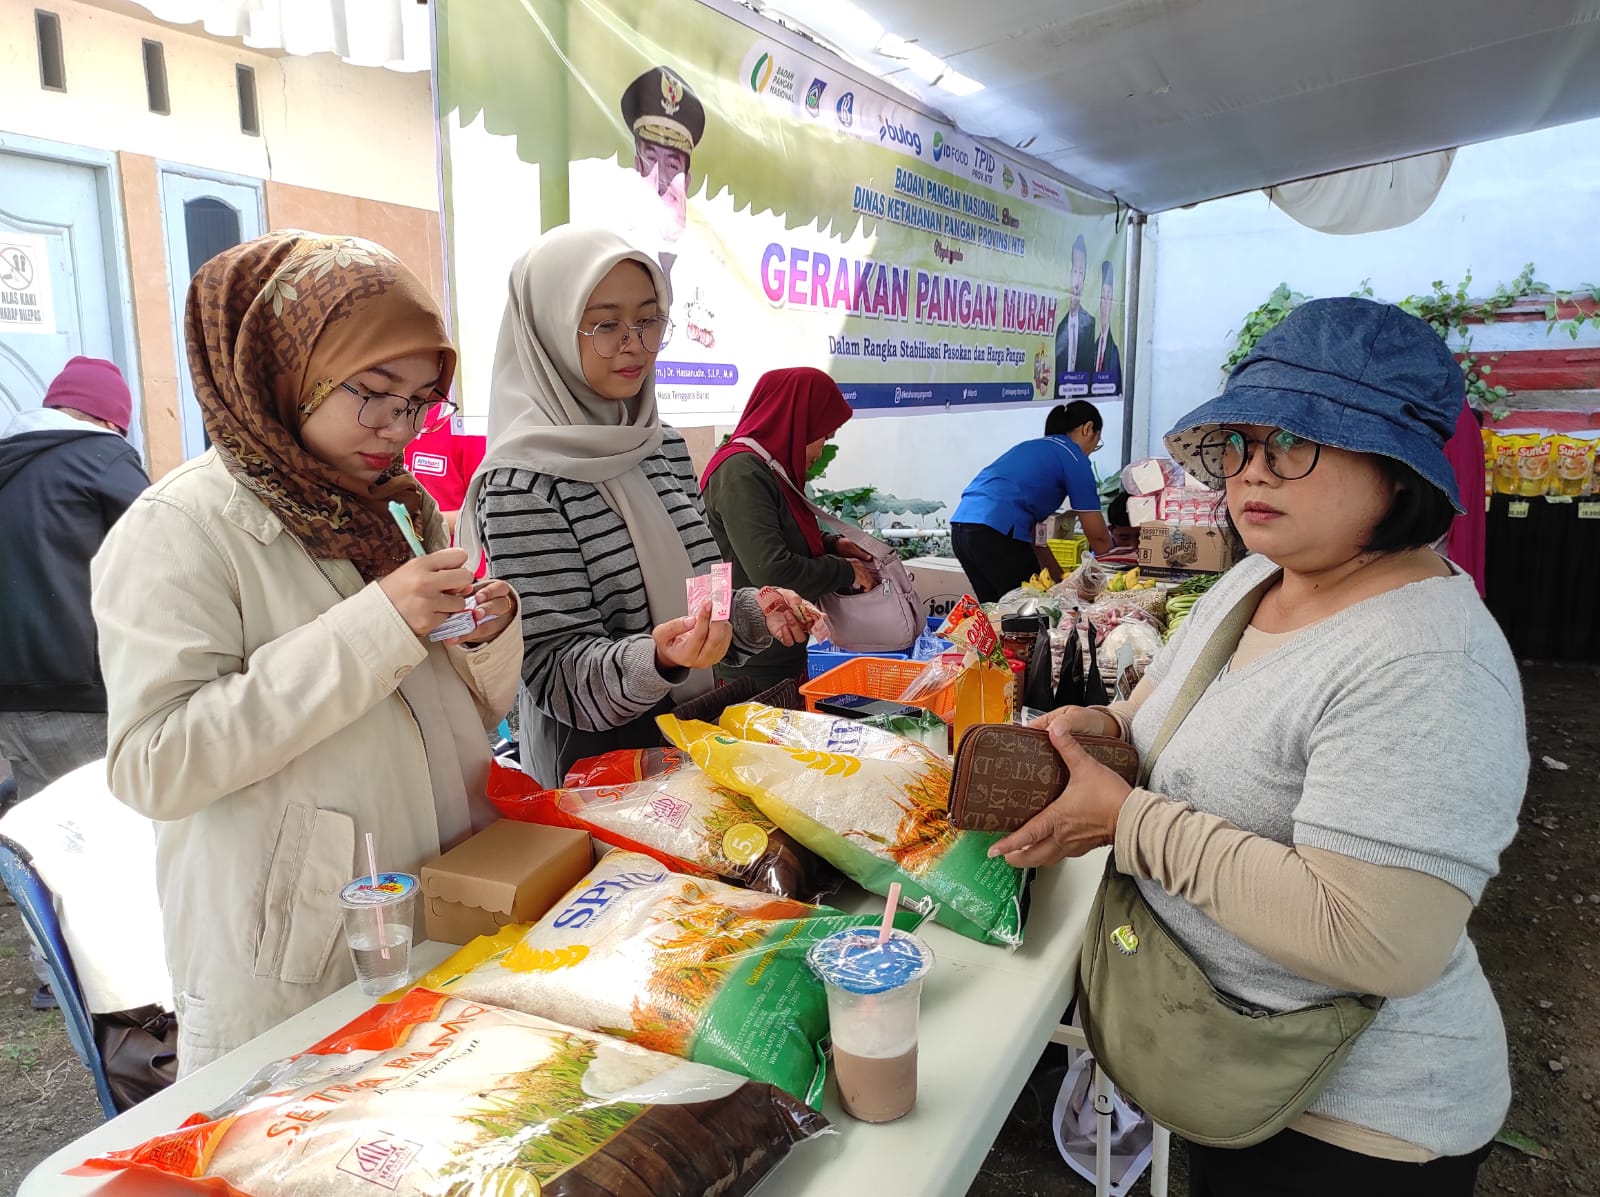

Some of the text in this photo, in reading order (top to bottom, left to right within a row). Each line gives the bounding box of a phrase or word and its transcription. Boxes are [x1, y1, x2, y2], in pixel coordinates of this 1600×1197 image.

[773, 74, 794, 91] PANGAN
[775, 65, 795, 82] BADAN
[769, 85, 795, 104] NASIONAL
[884, 119, 922, 156] bulog
[942, 143, 969, 167] ID FOOD
[974, 146, 995, 174] TPID
[894, 166, 925, 199] BADAN
[926, 177, 961, 209] PANGAN
[961, 187, 1000, 224] NASIONAL
[852, 185, 886, 217] DINAS
[887, 196, 943, 235] KETAHANAN
[943, 214, 977, 243] PANGAN
[978, 225, 1012, 252] PROVINSI
[1011, 236, 1026, 257] NTB
[1, 291, 37, 306] ALAS KAKI
[760, 241, 909, 321] GERAKAN
[915, 269, 999, 333] PANGAN
[1001, 287, 1058, 339] MURAH
[19, 308, 42, 322] DILEPAS
[829, 334, 1026, 365] Dalam Rangka Stabilisasi Pasokan dan Harga Pangan
[667, 367, 675, 377] Dr.
[657, 390, 710, 402] Nusa Tenggara Barat
[1142, 549, 1149, 559] 8
[1163, 540, 1197, 560] Sunlight
[929, 598, 956, 617] joll
[731, 838, 753, 856] 5
[265, 1074, 394, 1147] SETRA
[383, 1003, 500, 1073] RAMO
[378, 1145, 411, 1181] HALAL
